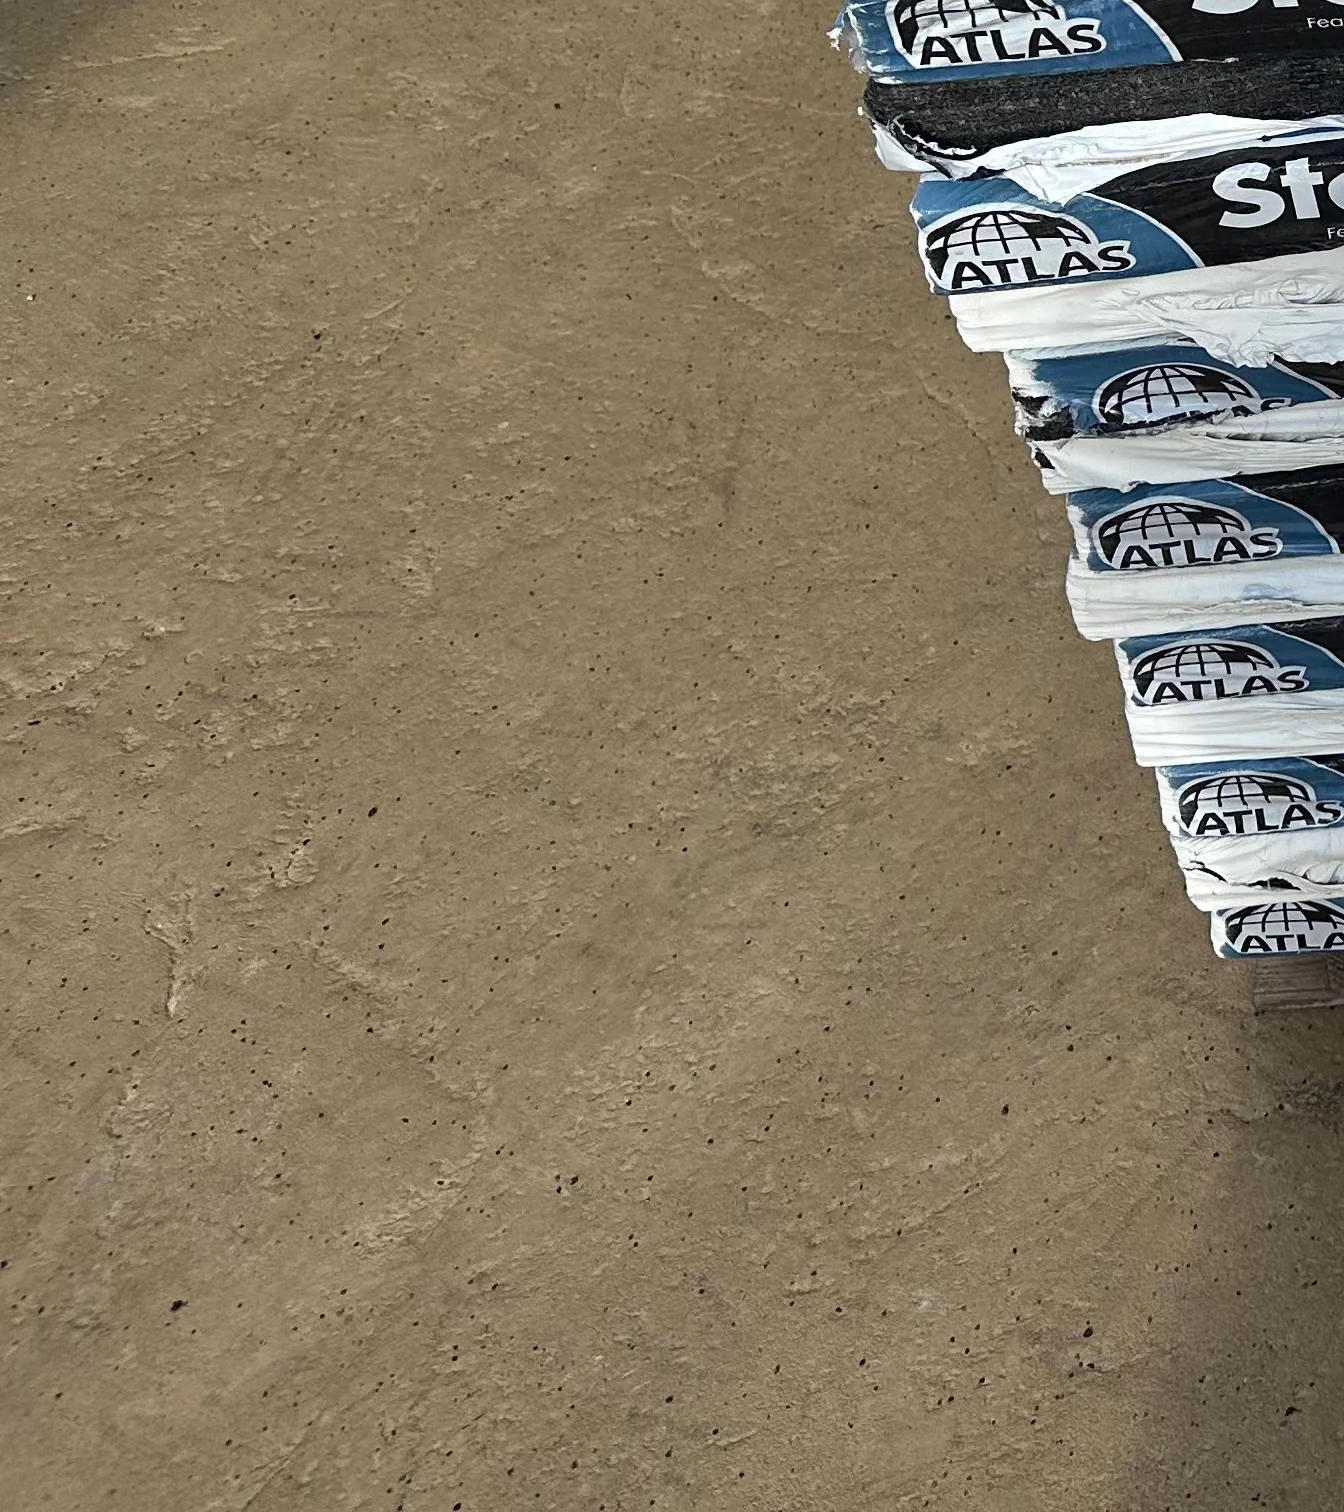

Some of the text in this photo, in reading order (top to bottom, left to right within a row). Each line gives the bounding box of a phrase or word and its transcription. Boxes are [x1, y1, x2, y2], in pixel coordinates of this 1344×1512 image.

[921, 23, 1103, 66] ATLAS
[952, 243, 1135, 289] ATLAS
[1118, 531, 1280, 569] ATLAS
[1153, 668, 1308, 705] ATLAS
[1195, 800, 1343, 836] ATLAS
